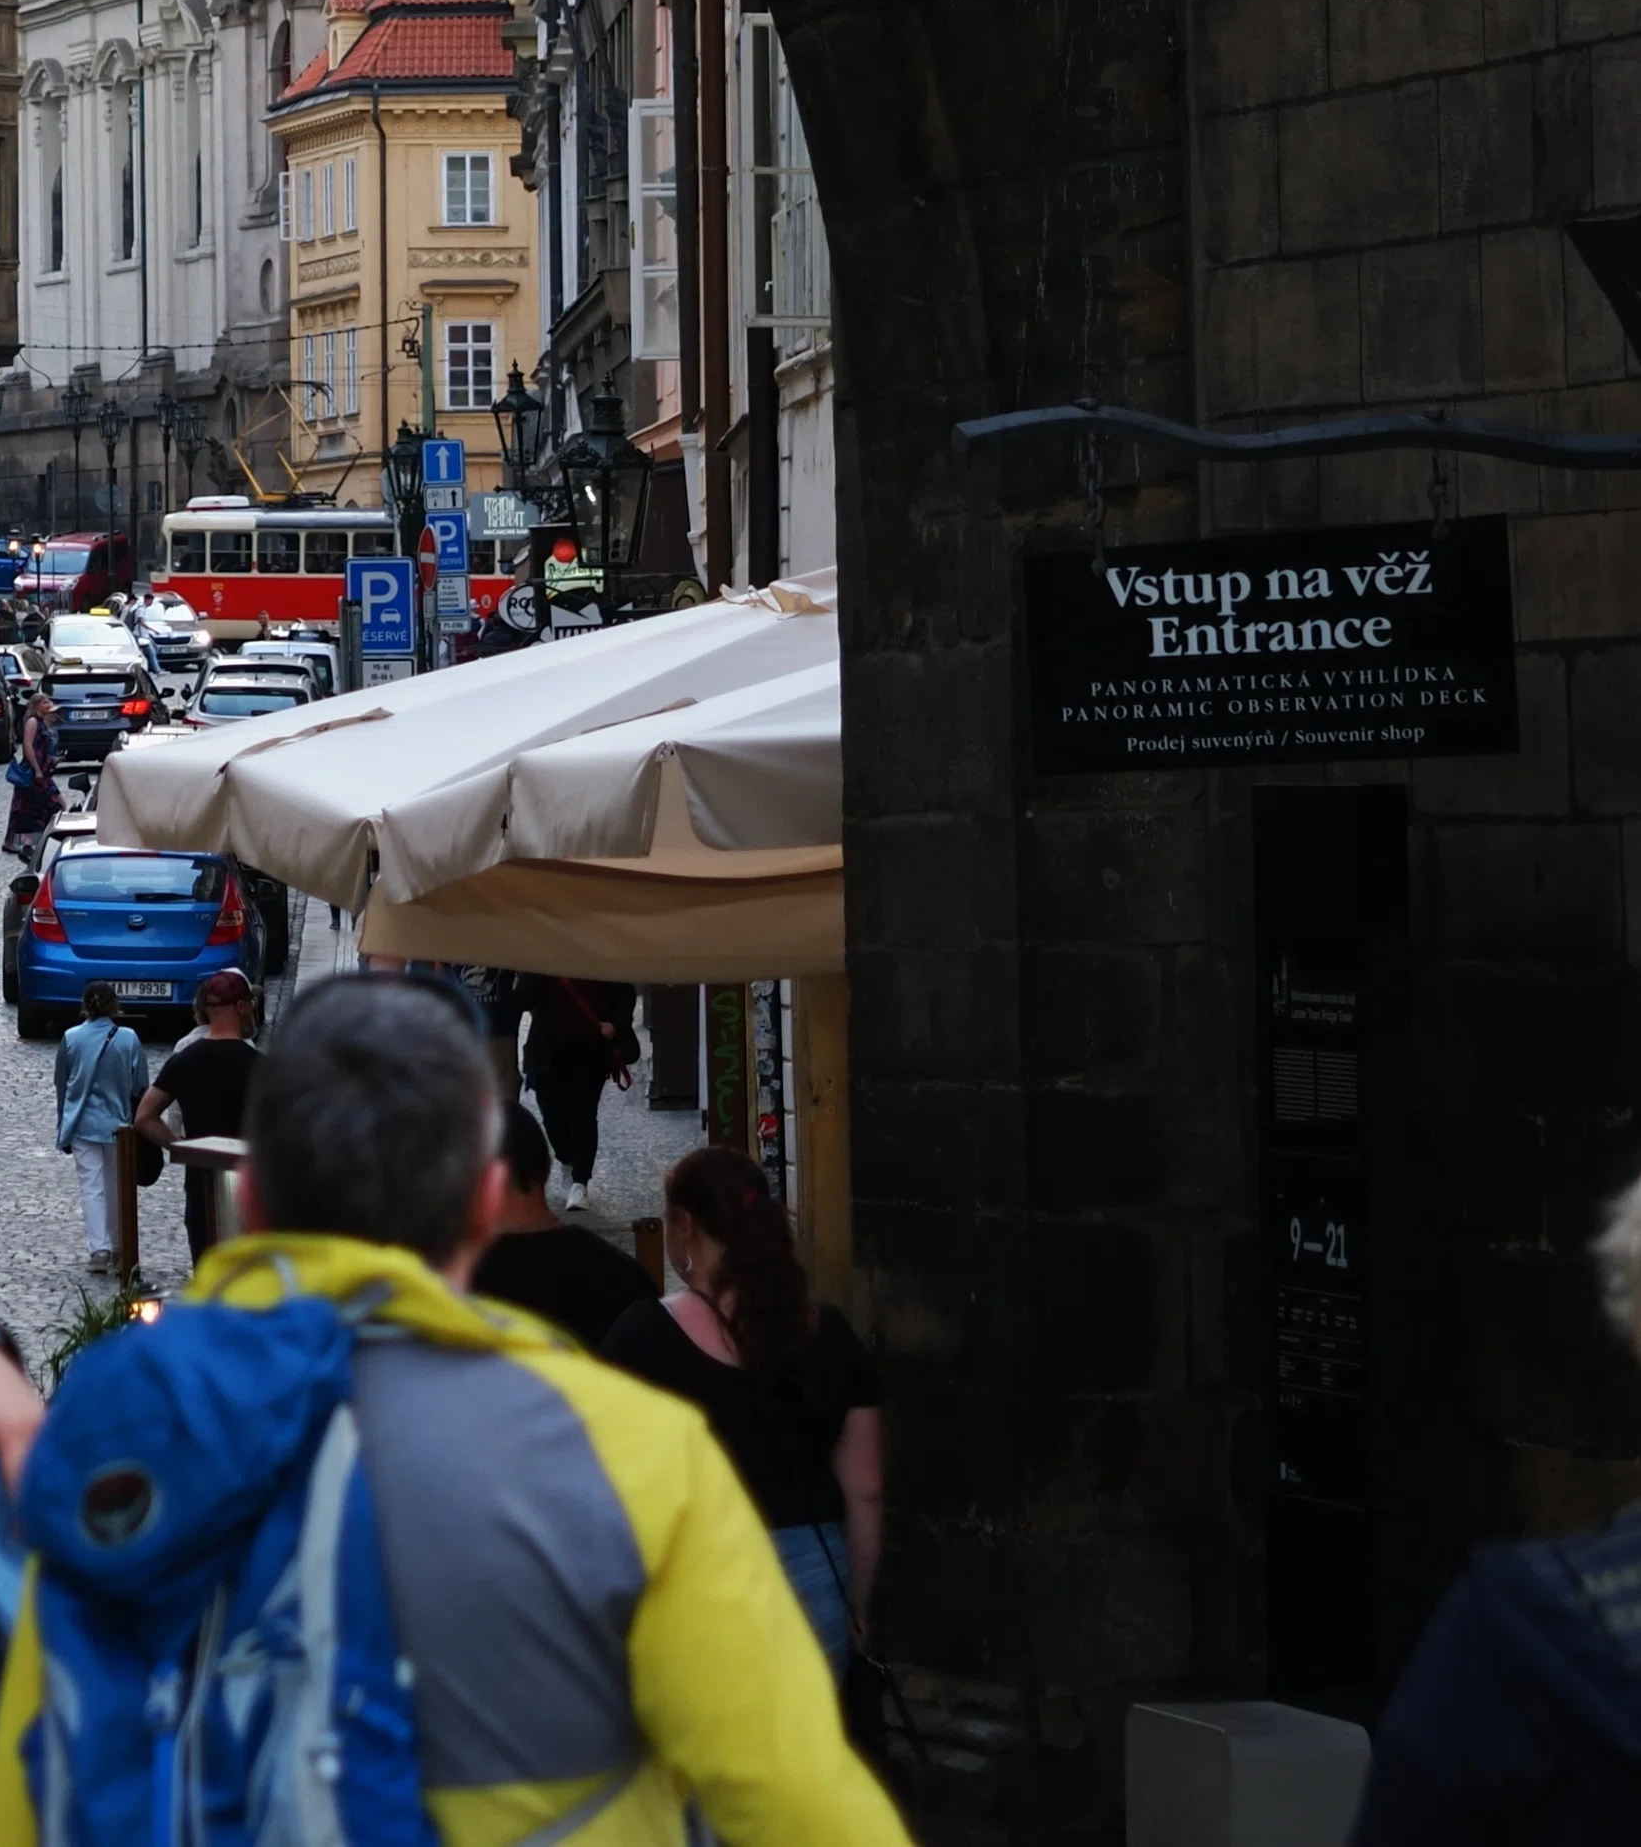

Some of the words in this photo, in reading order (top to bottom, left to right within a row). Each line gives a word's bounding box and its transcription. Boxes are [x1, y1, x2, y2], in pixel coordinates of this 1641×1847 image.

[440, 557, 463, 566] SERVÉ
[361, 571, 399, 624] P
[1105, 565, 1252, 617] Vstup
[1264, 566, 1334, 602] na
[1342, 550, 1434, 597] věž
[362, 628, 409, 642] ÉSERVÉ
[1147, 615, 1394, 658] Entrance
[1089, 670, 1312, 697] PANORAMATICKÁ
[1323, 666, 1457, 687] VYHLÍDKA
[1062, 701, 1214, 723] PANORAMIC
[1228, 691, 1406, 715] OBSERVATION
[1420, 687, 1489, 707] DECK
[1126, 733, 1187, 755] Prodej
[1191, 728, 1275, 751] suvenýrů
[1294, 728, 1375, 747] Souvenir
[1380, 725, 1426, 745] shop
[139, 983, 167, 995] 9936
